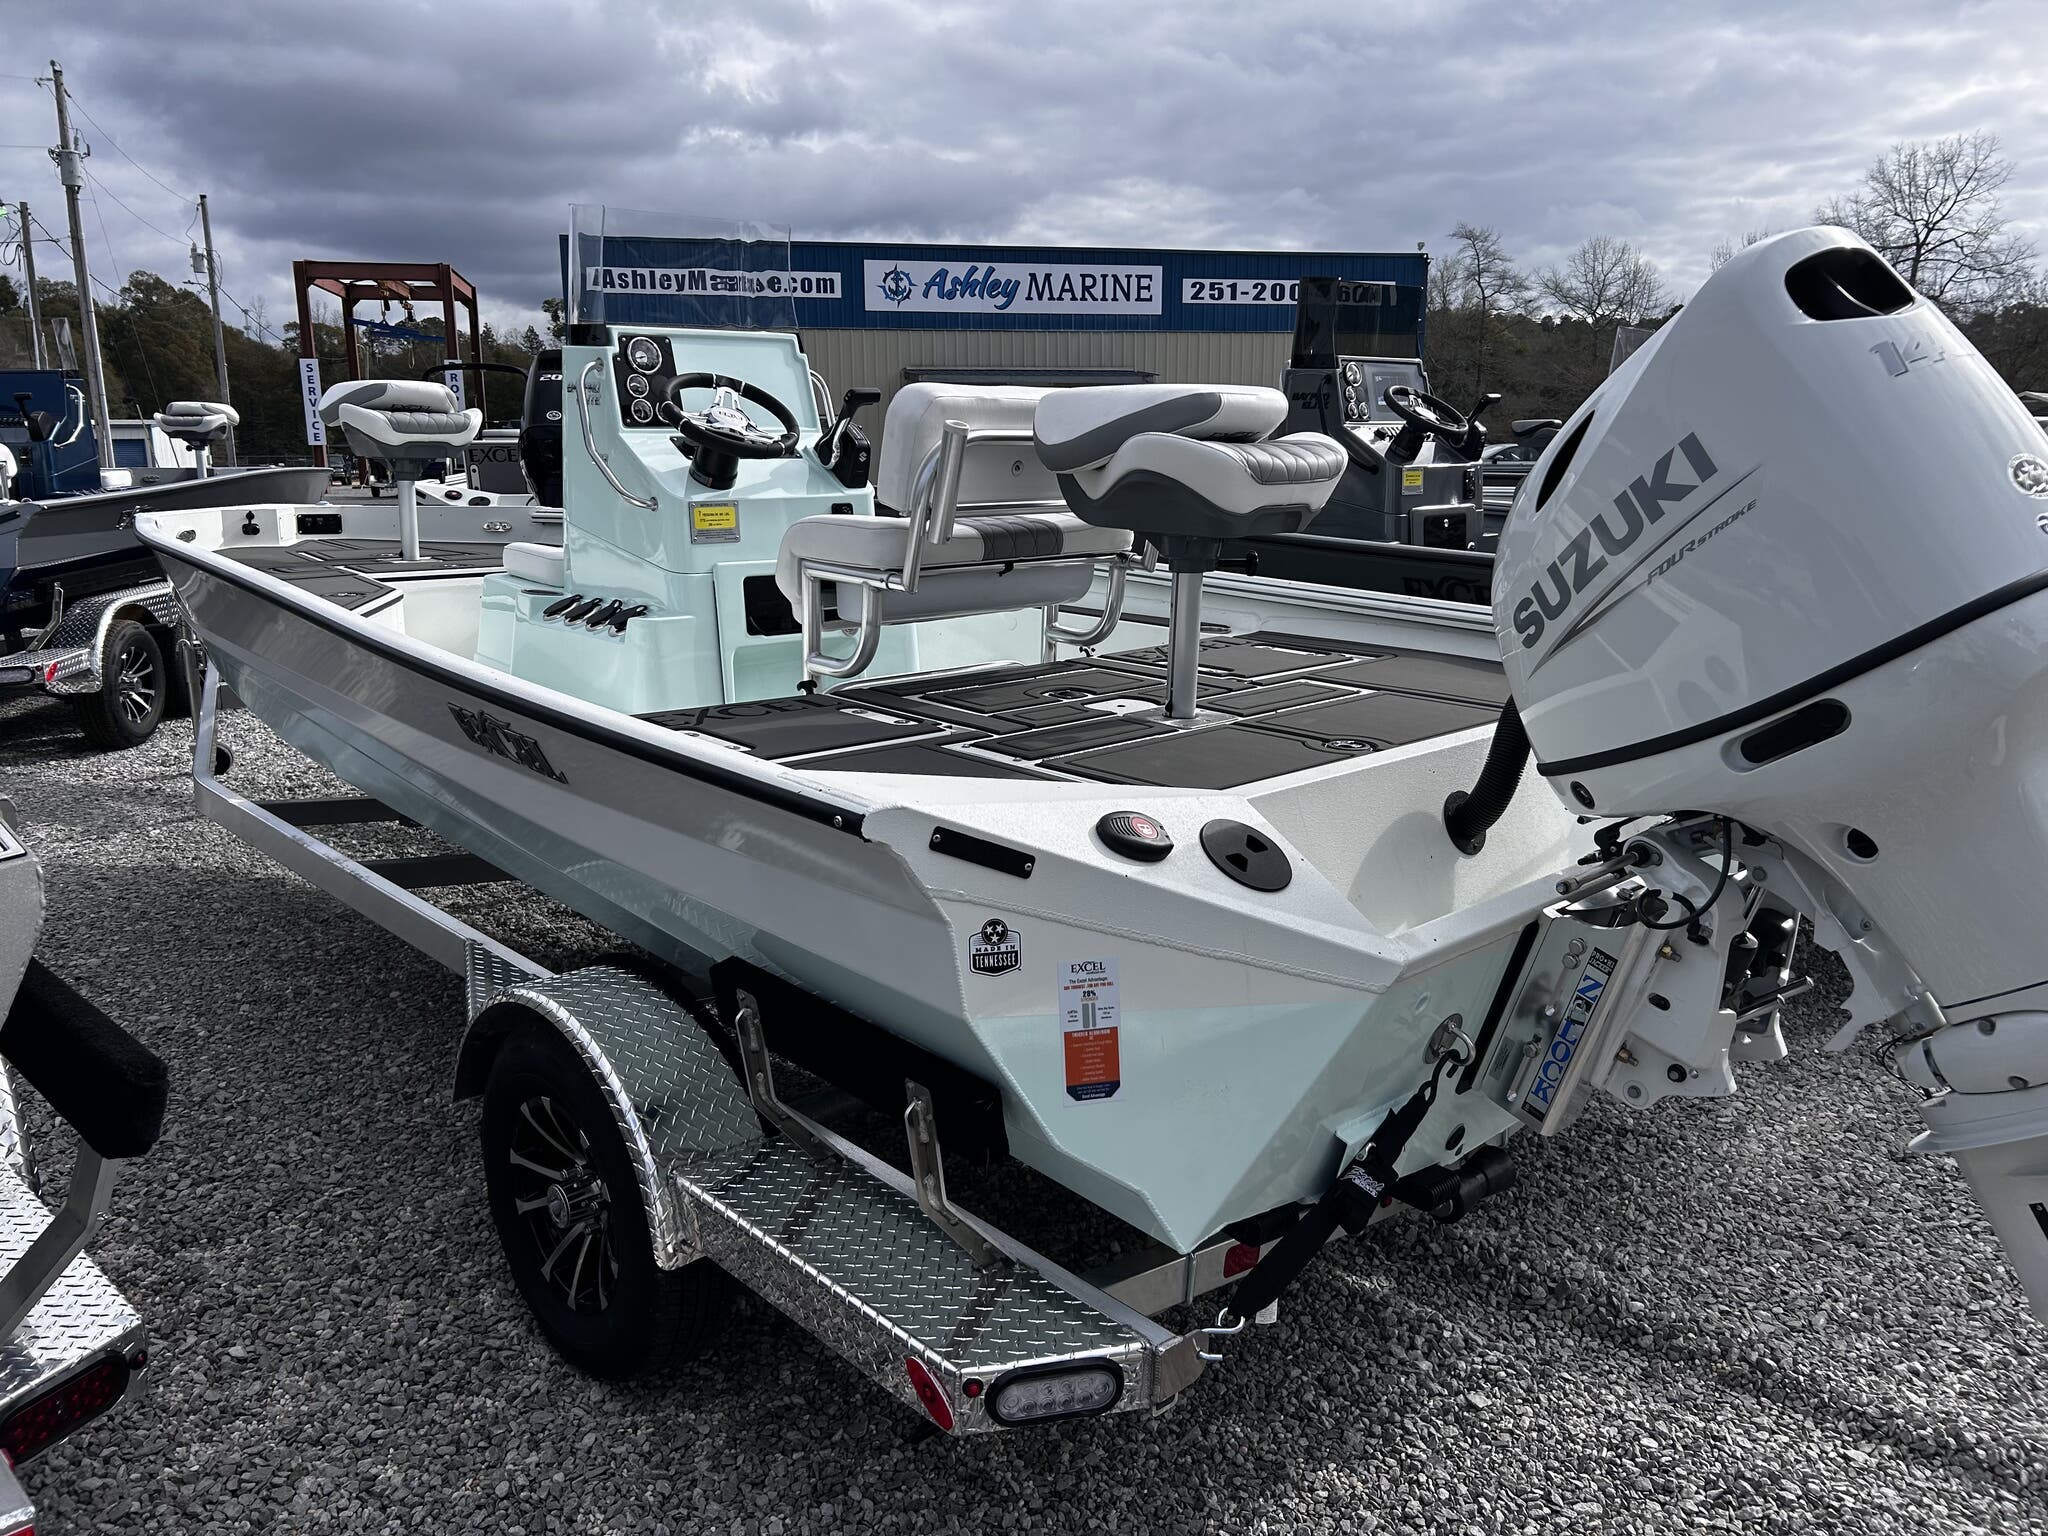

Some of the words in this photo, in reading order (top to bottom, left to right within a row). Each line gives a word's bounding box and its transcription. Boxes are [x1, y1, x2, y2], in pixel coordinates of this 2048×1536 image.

[602, 268, 836, 295] AshleyMae.com
[921, 264, 1021, 311] Ashley
[1025, 272, 1154, 303] MARINE
[305, 363, 321, 443] SERVICE
[469, 445, 519, 464] EXCE
[1513, 432, 1719, 649] SUZUKI
[1401, 575, 1491, 604] EXCE
[645, 695, 843, 727] EXCEL
[975, 945, 1002, 953] MADE
[975, 952, 1016, 968] TENNESSEE
[1071, 961, 1106, 974] EXCEL
